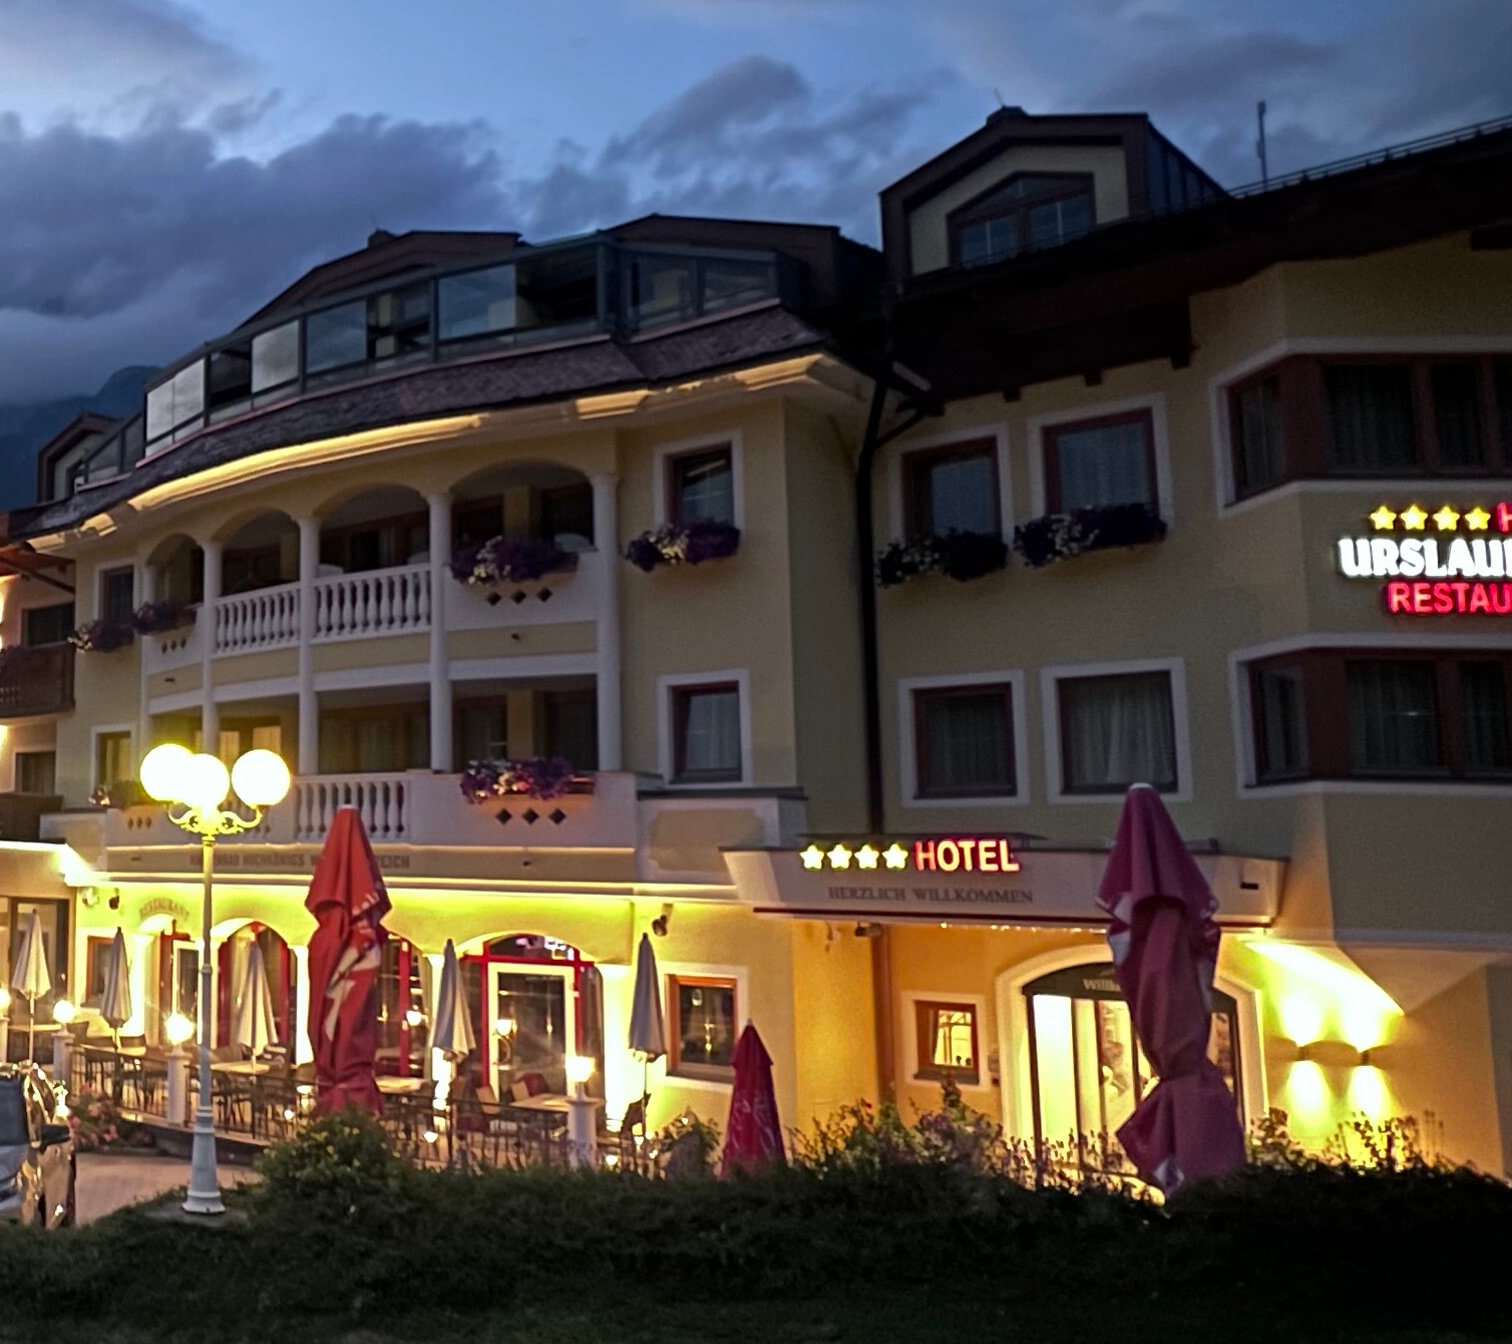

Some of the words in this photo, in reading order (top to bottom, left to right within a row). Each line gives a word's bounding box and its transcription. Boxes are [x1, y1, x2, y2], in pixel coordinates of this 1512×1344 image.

[1338, 536, 1512, 577] URSLAU
[915, 839, 1020, 872] HOTEL
[827, 886, 906, 902] HERZLICH
[912, 887, 1034, 903] WILLKOMMEN
